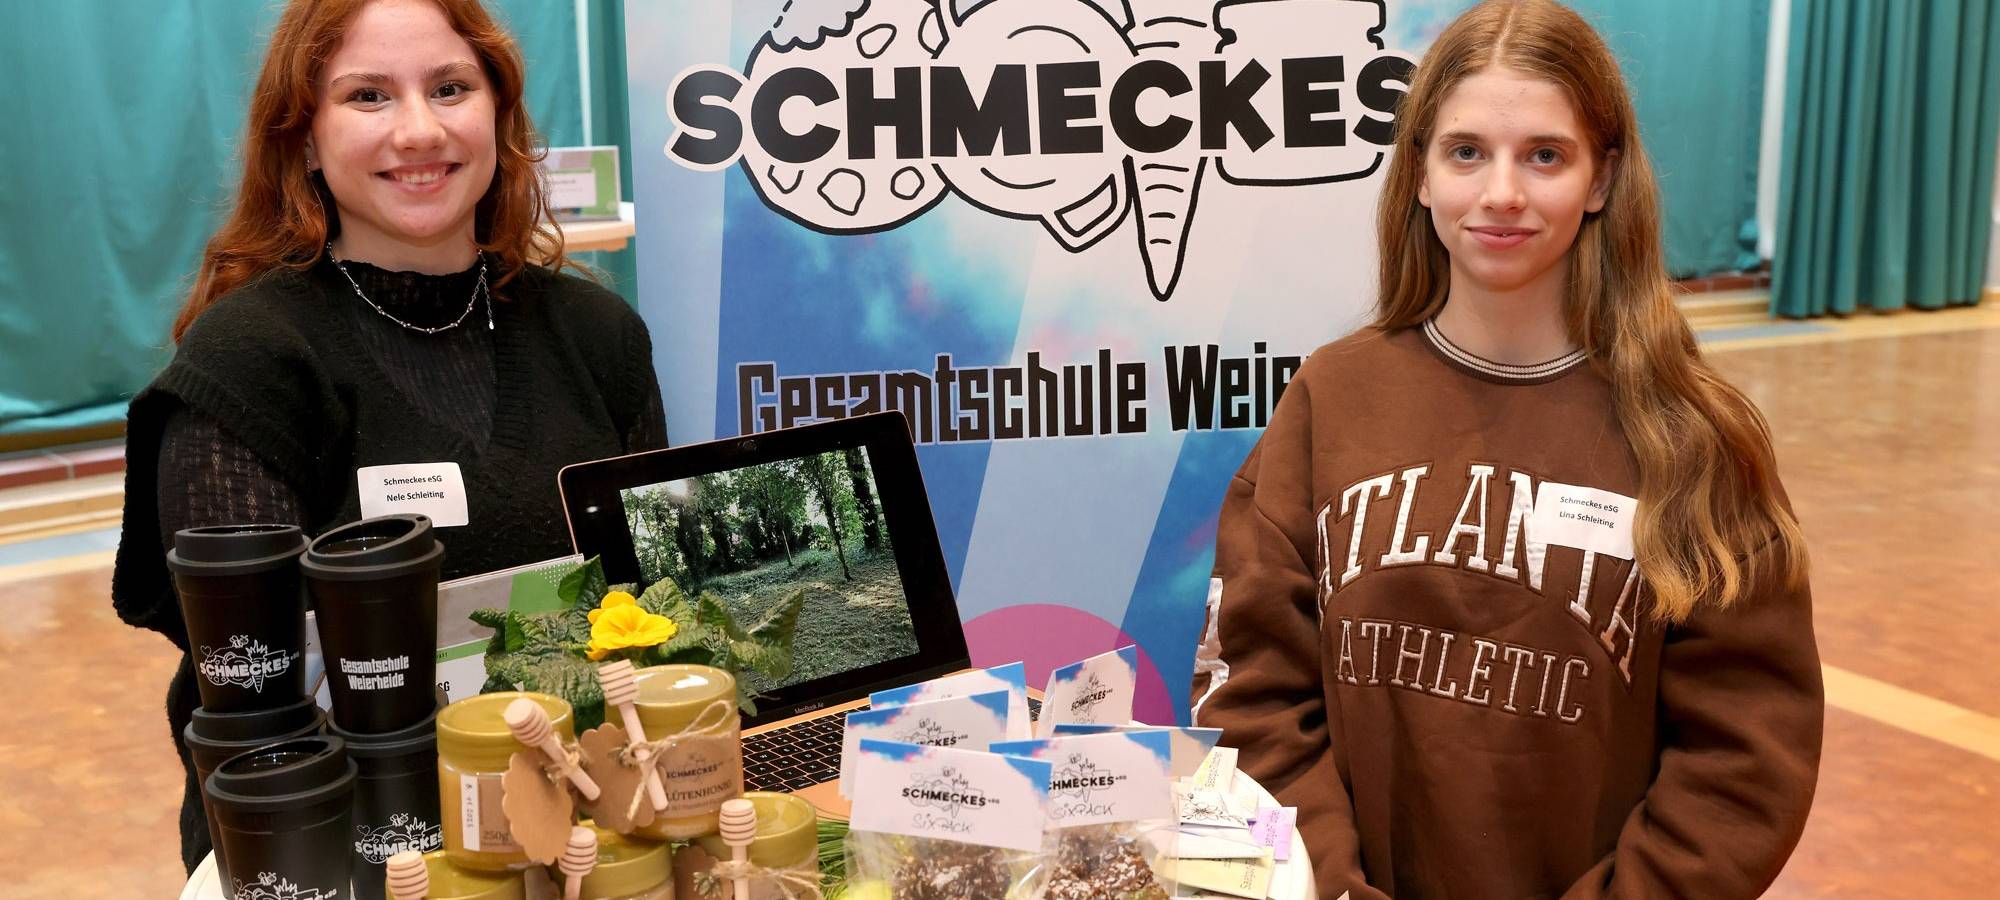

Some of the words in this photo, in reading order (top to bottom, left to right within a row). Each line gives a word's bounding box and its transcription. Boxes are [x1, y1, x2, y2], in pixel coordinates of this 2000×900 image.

[671, 56, 1417, 164] SCHMECKES
[739, 349, 1147, 442] Gesamtschule
[1165, 342, 1302, 432] Weie
[383, 476, 427, 486] Schmeckes
[428, 475, 443, 483] eSG
[386, 493, 405, 502] Nele
[407, 490, 445, 500] Schleiting
[1560, 496, 1602, 509] Schmeckes
[1603, 504, 1619, 513] eSG
[1559, 511, 1575, 519] Lina
[1577, 513, 1615, 529] Schleiting
[200, 656, 290, 678] SCHMECKES
[340, 655, 410, 674] Gesamtschule
[1337, 619, 1590, 723] ATHLETIC
[347, 672, 405, 690] Weierheide
[667, 779, 732, 800] LÜTENHONIG
[1048, 776, 1114, 791] HMECKES
[902, 788, 986, 807] SCHMECKES
